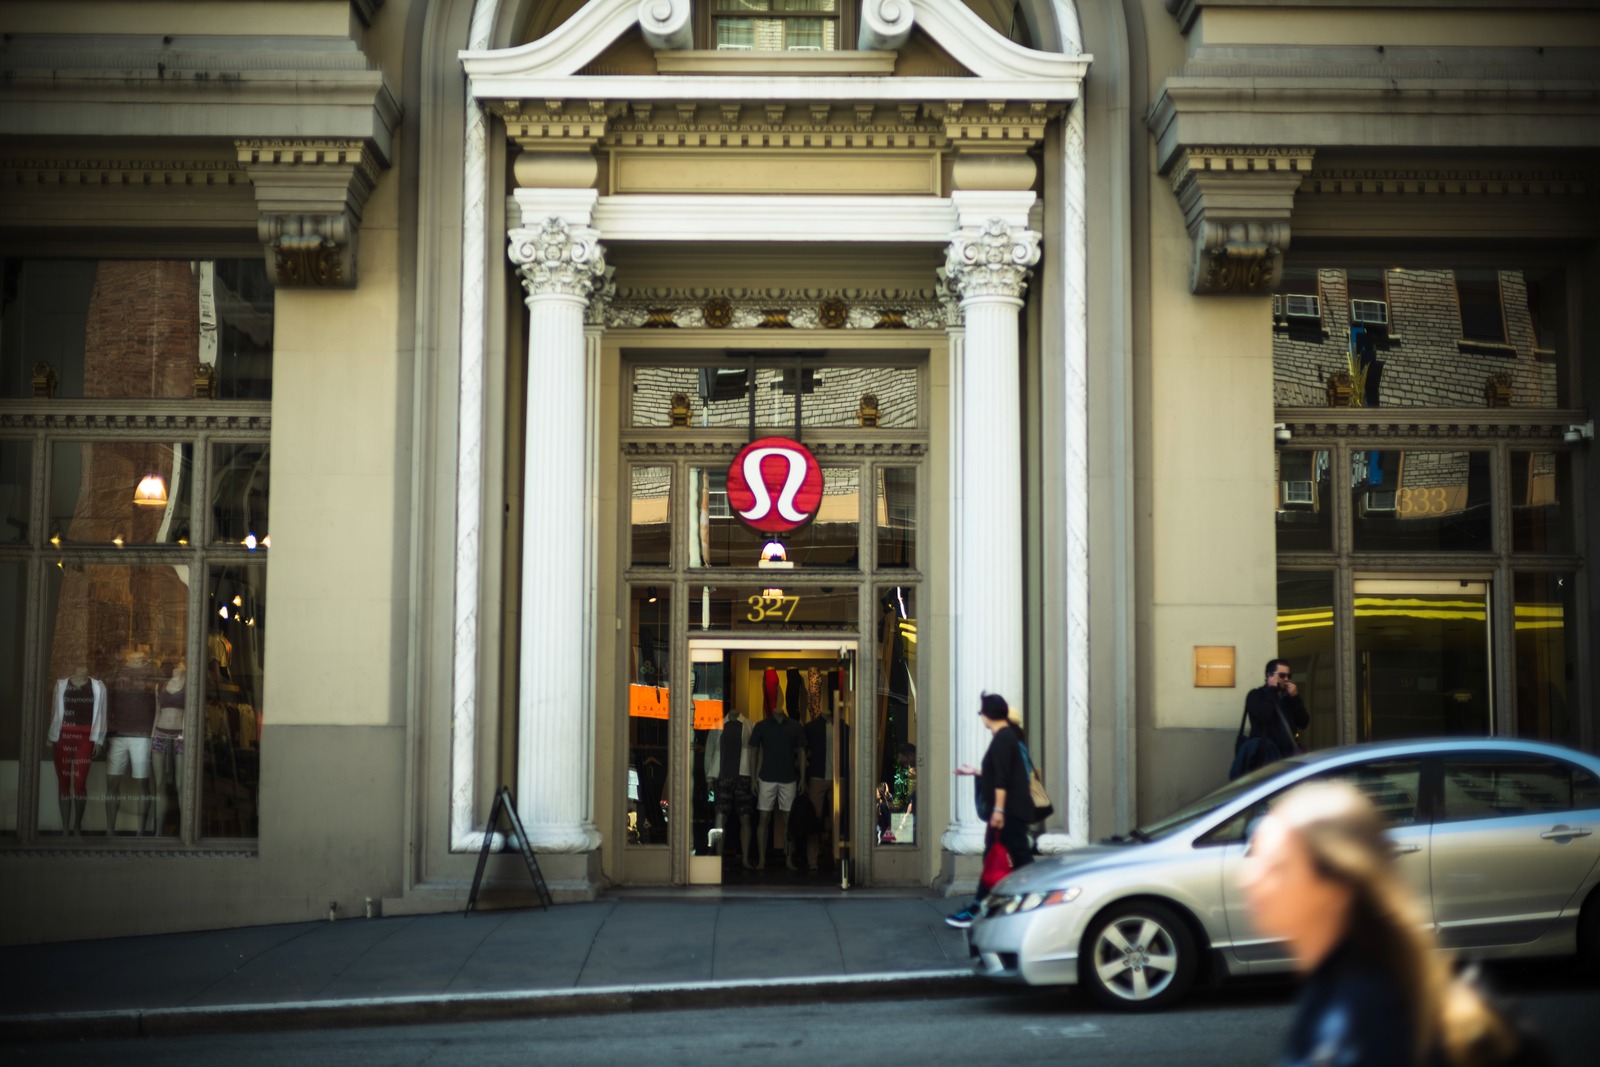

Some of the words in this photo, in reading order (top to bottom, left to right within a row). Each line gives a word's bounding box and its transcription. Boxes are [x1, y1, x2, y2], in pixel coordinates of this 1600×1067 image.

[1397, 488, 1448, 513] 333
[747, 595, 800, 622] 327
[64, 696, 94, 704] Draymond
[62, 744, 78, 752] West
[62, 757, 92, 765] Livingston
[61, 769, 80, 777] Young
